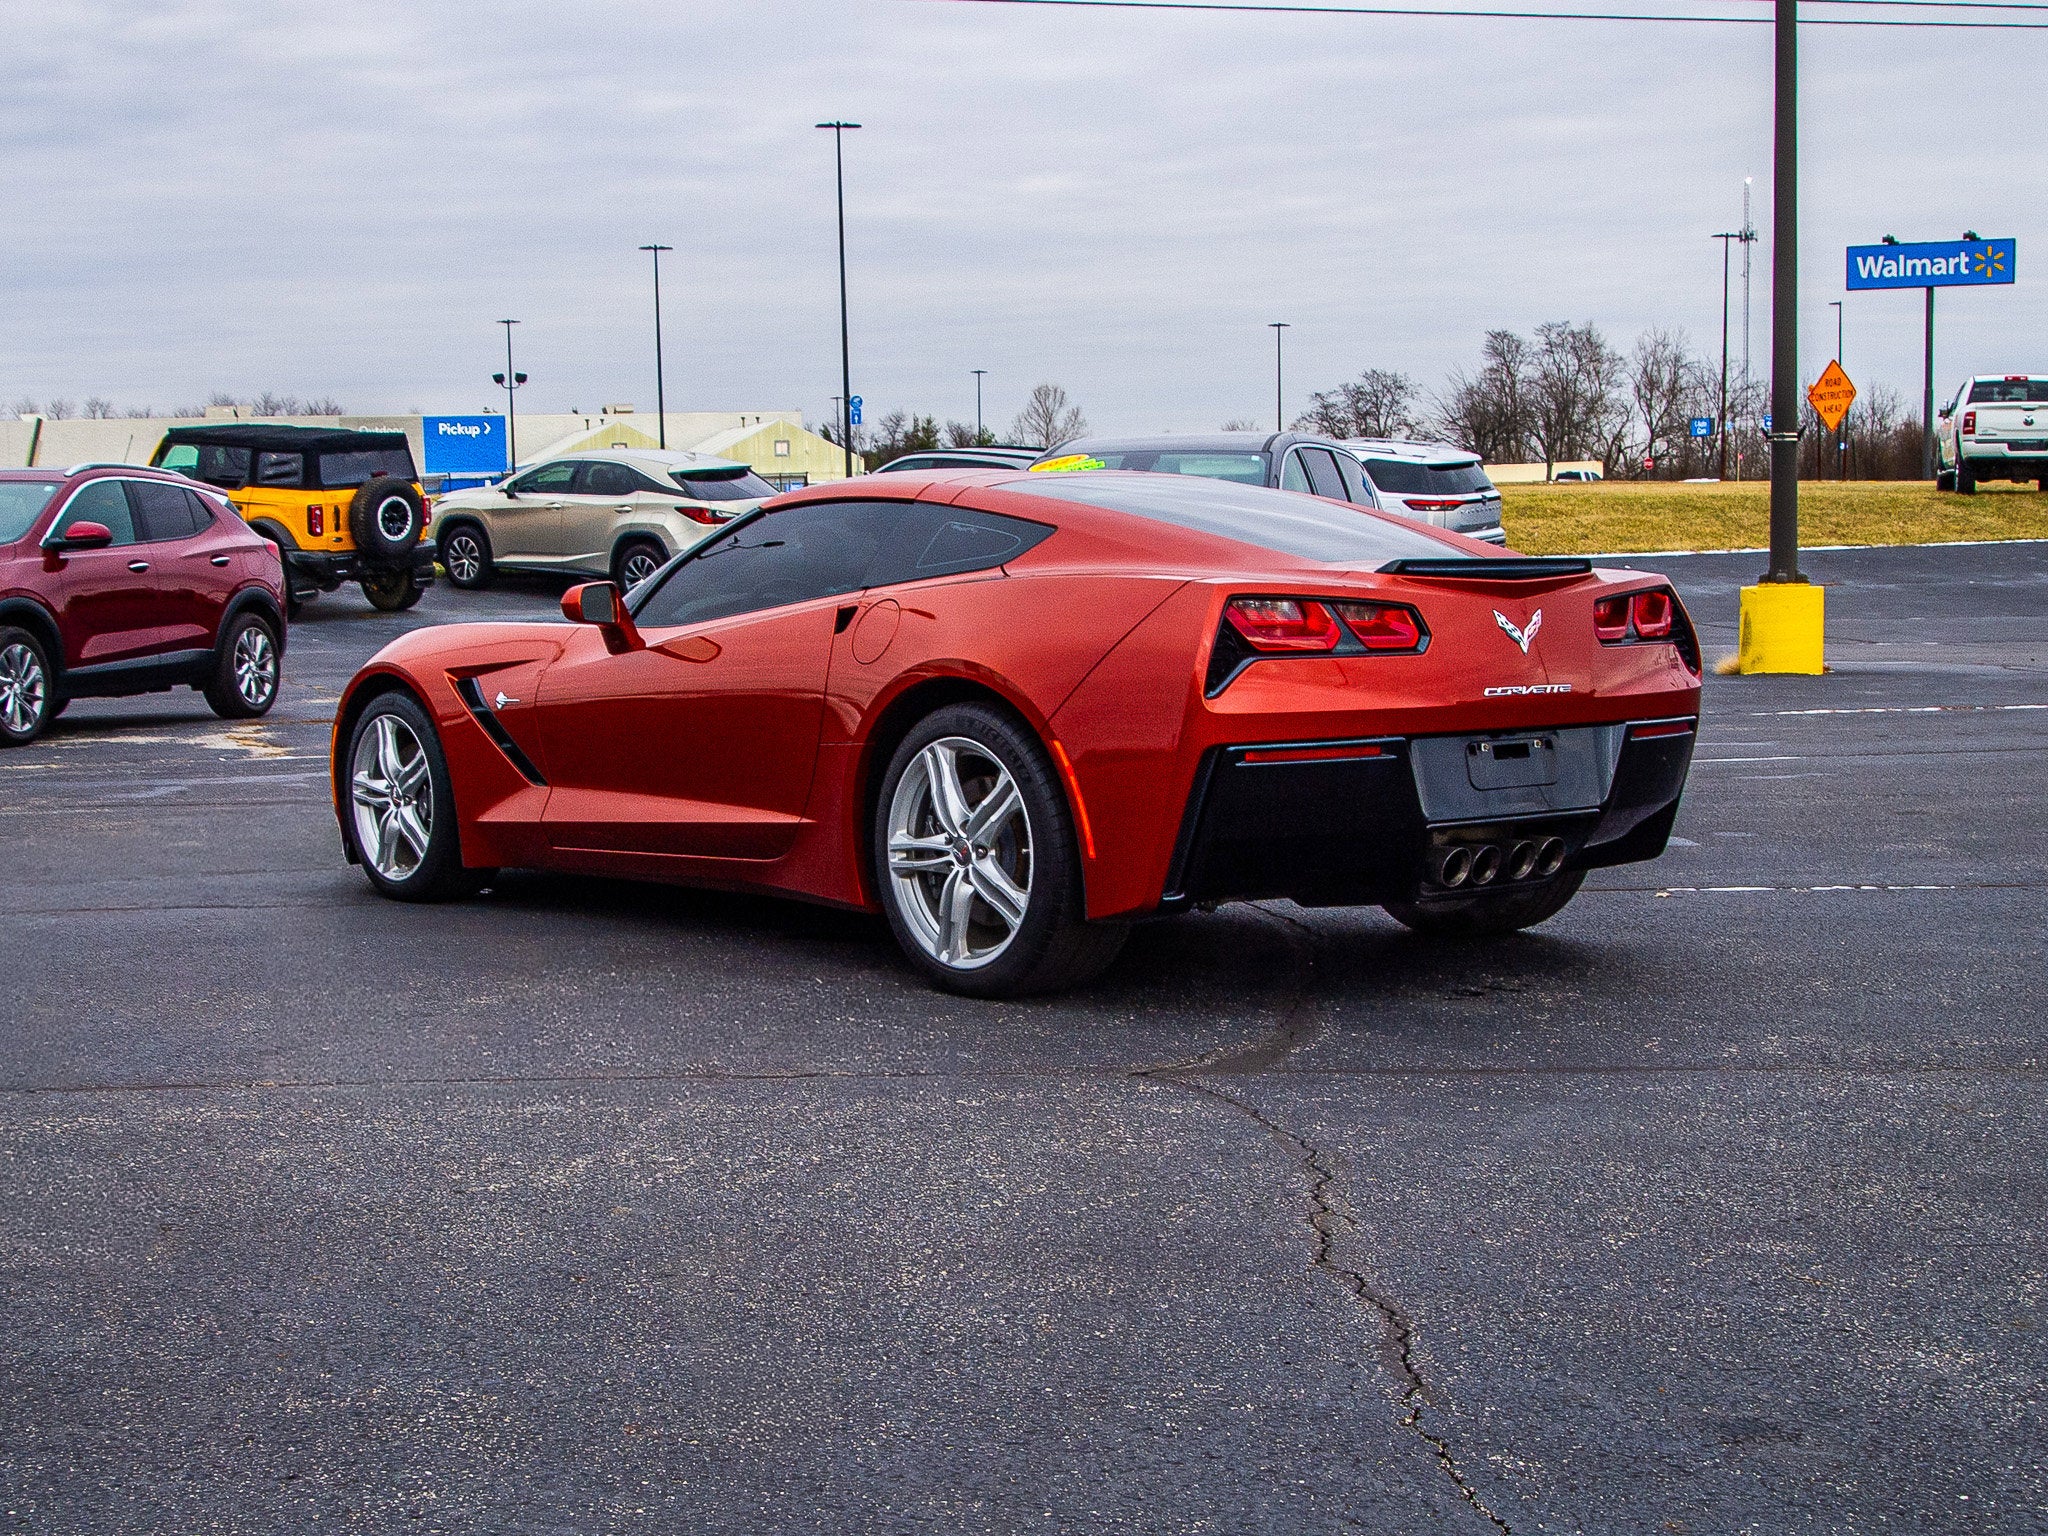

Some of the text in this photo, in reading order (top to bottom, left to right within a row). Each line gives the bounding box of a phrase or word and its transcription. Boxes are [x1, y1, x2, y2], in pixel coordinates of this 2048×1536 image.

[1856, 251, 1970, 279] Walmart
[1825, 377, 1842, 387] ROAD
[1810, 389, 1854, 402] CONSTRUCTION
[1823, 403, 1842, 413] AHEAD
[438, 422, 481, 439] Pickup
[1483, 684, 1572, 697] CORVETTE
